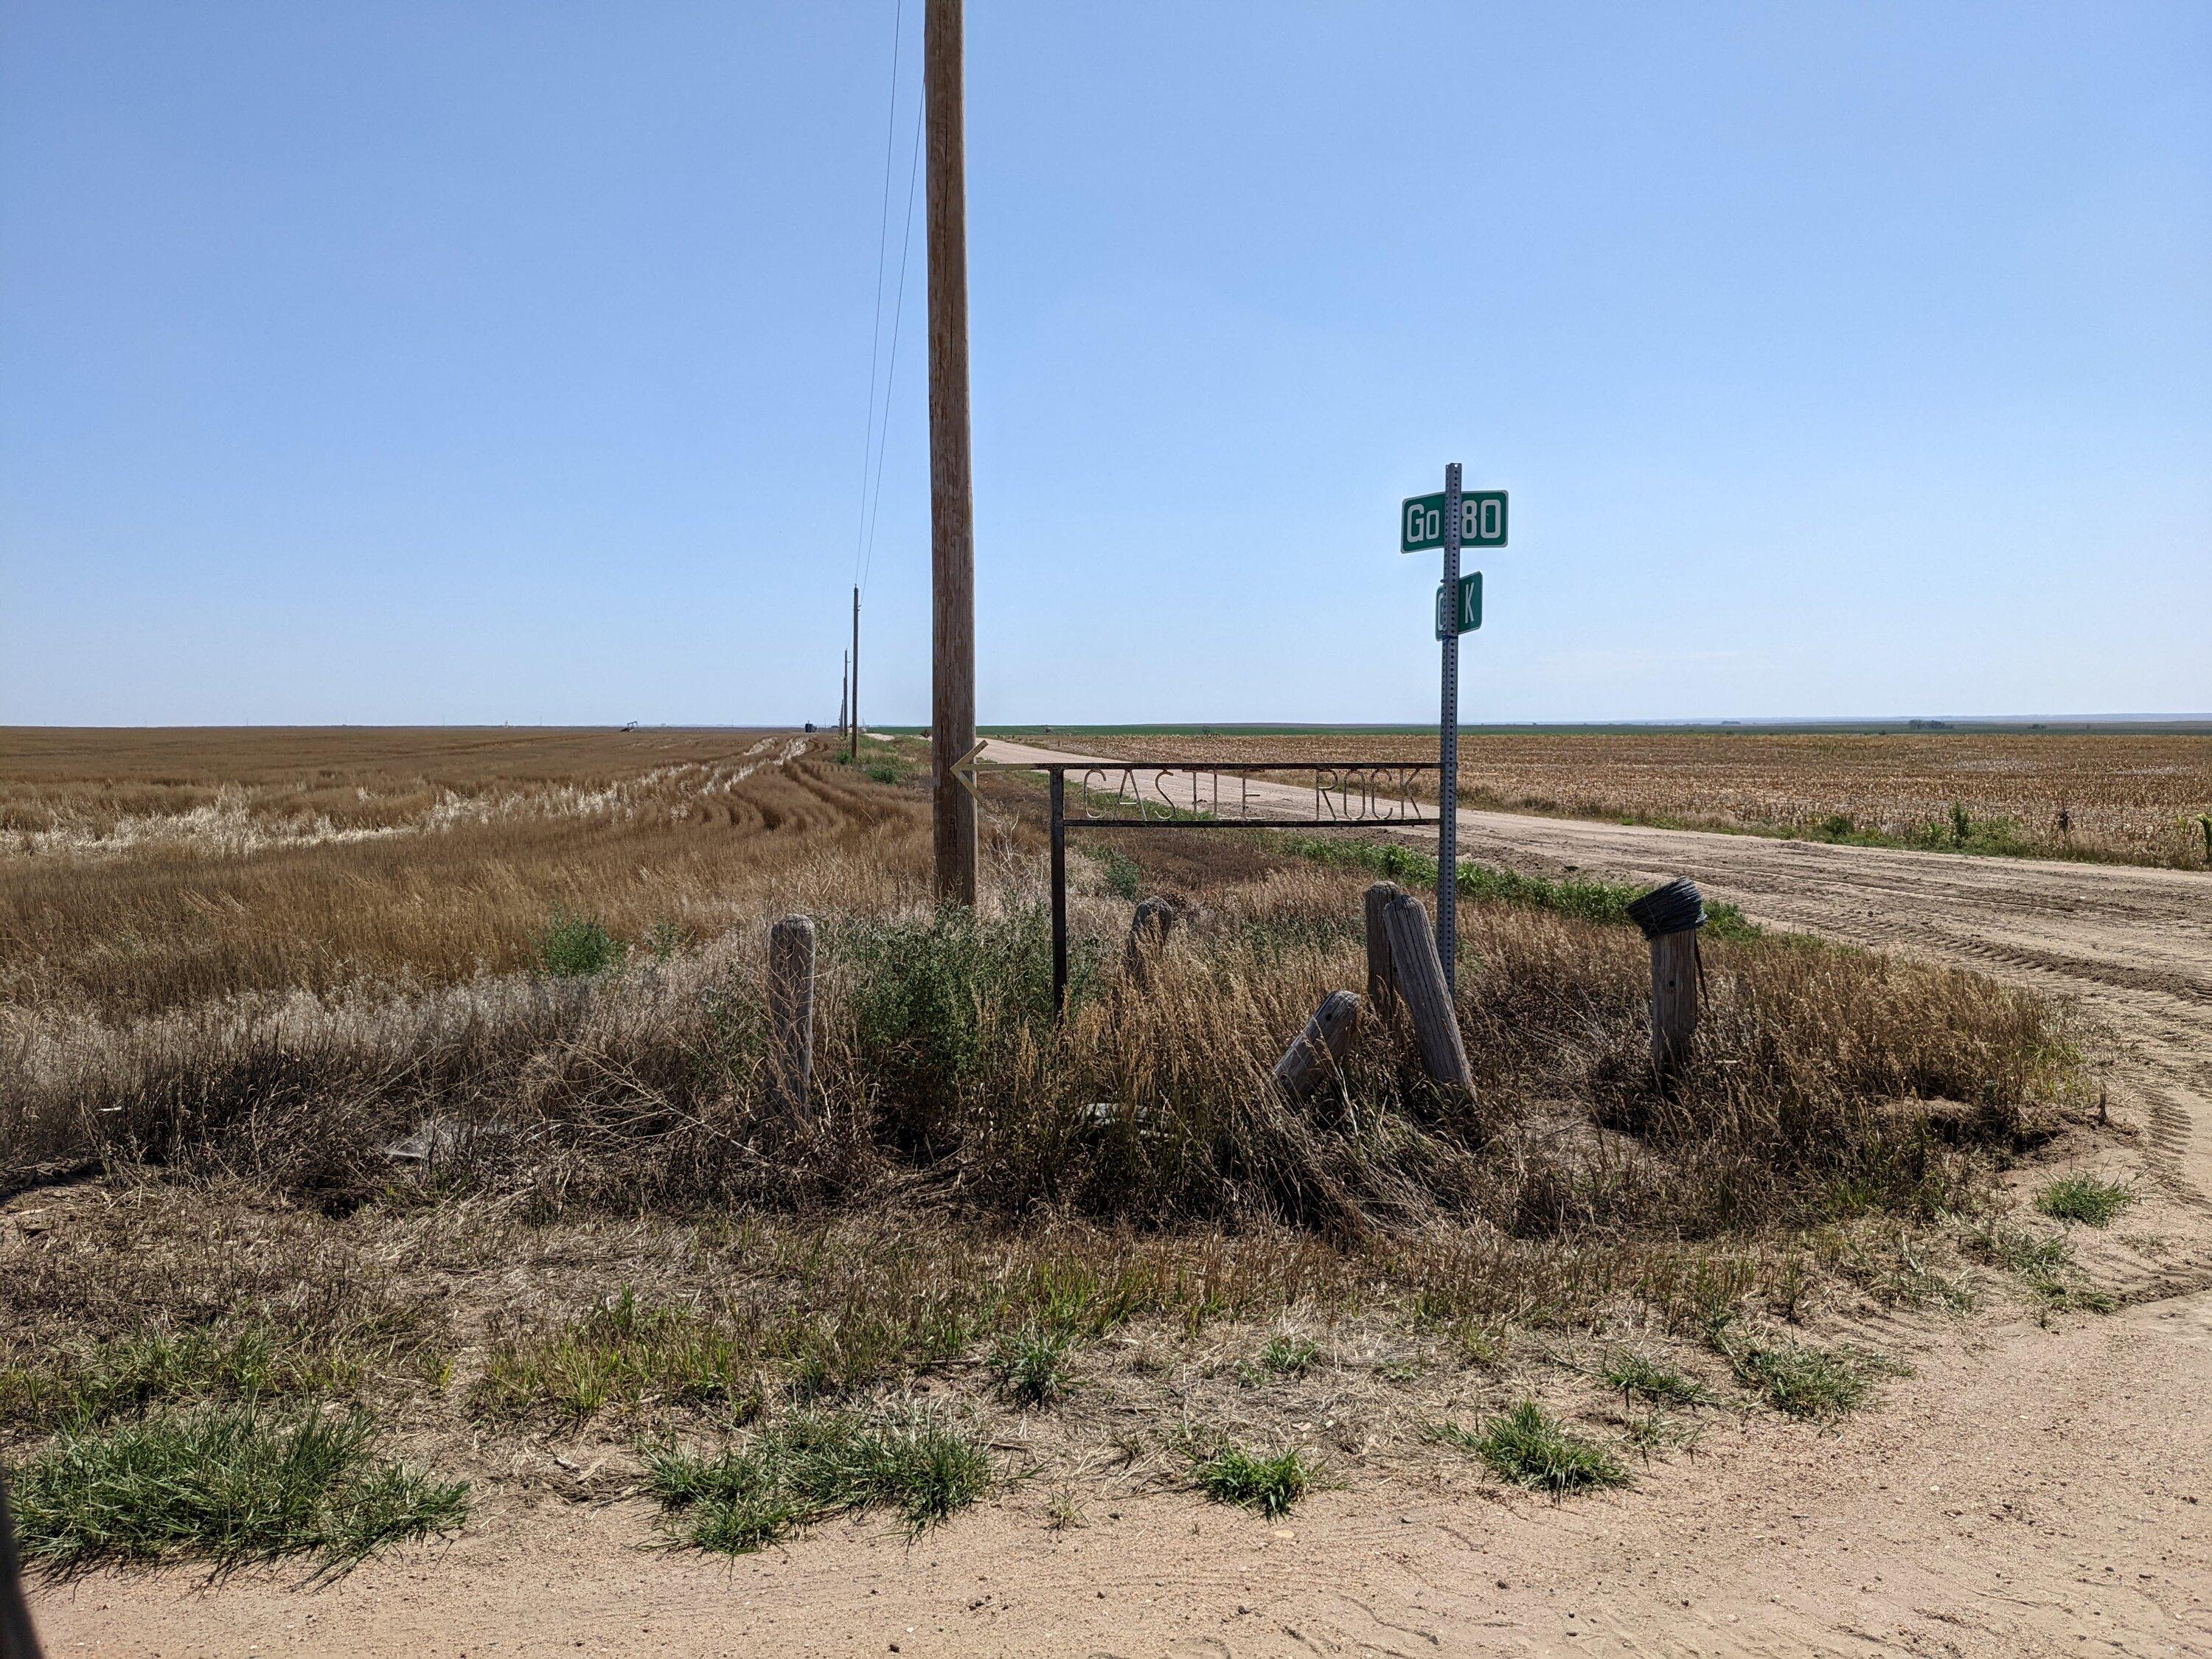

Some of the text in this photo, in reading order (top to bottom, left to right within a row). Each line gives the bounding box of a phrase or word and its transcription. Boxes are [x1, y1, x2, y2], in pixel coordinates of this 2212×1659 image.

[1407, 499, 1501, 543] Go 80
[1464, 582, 1474, 624] K
[1083, 768, 1422, 821] CASTLE ROCK
